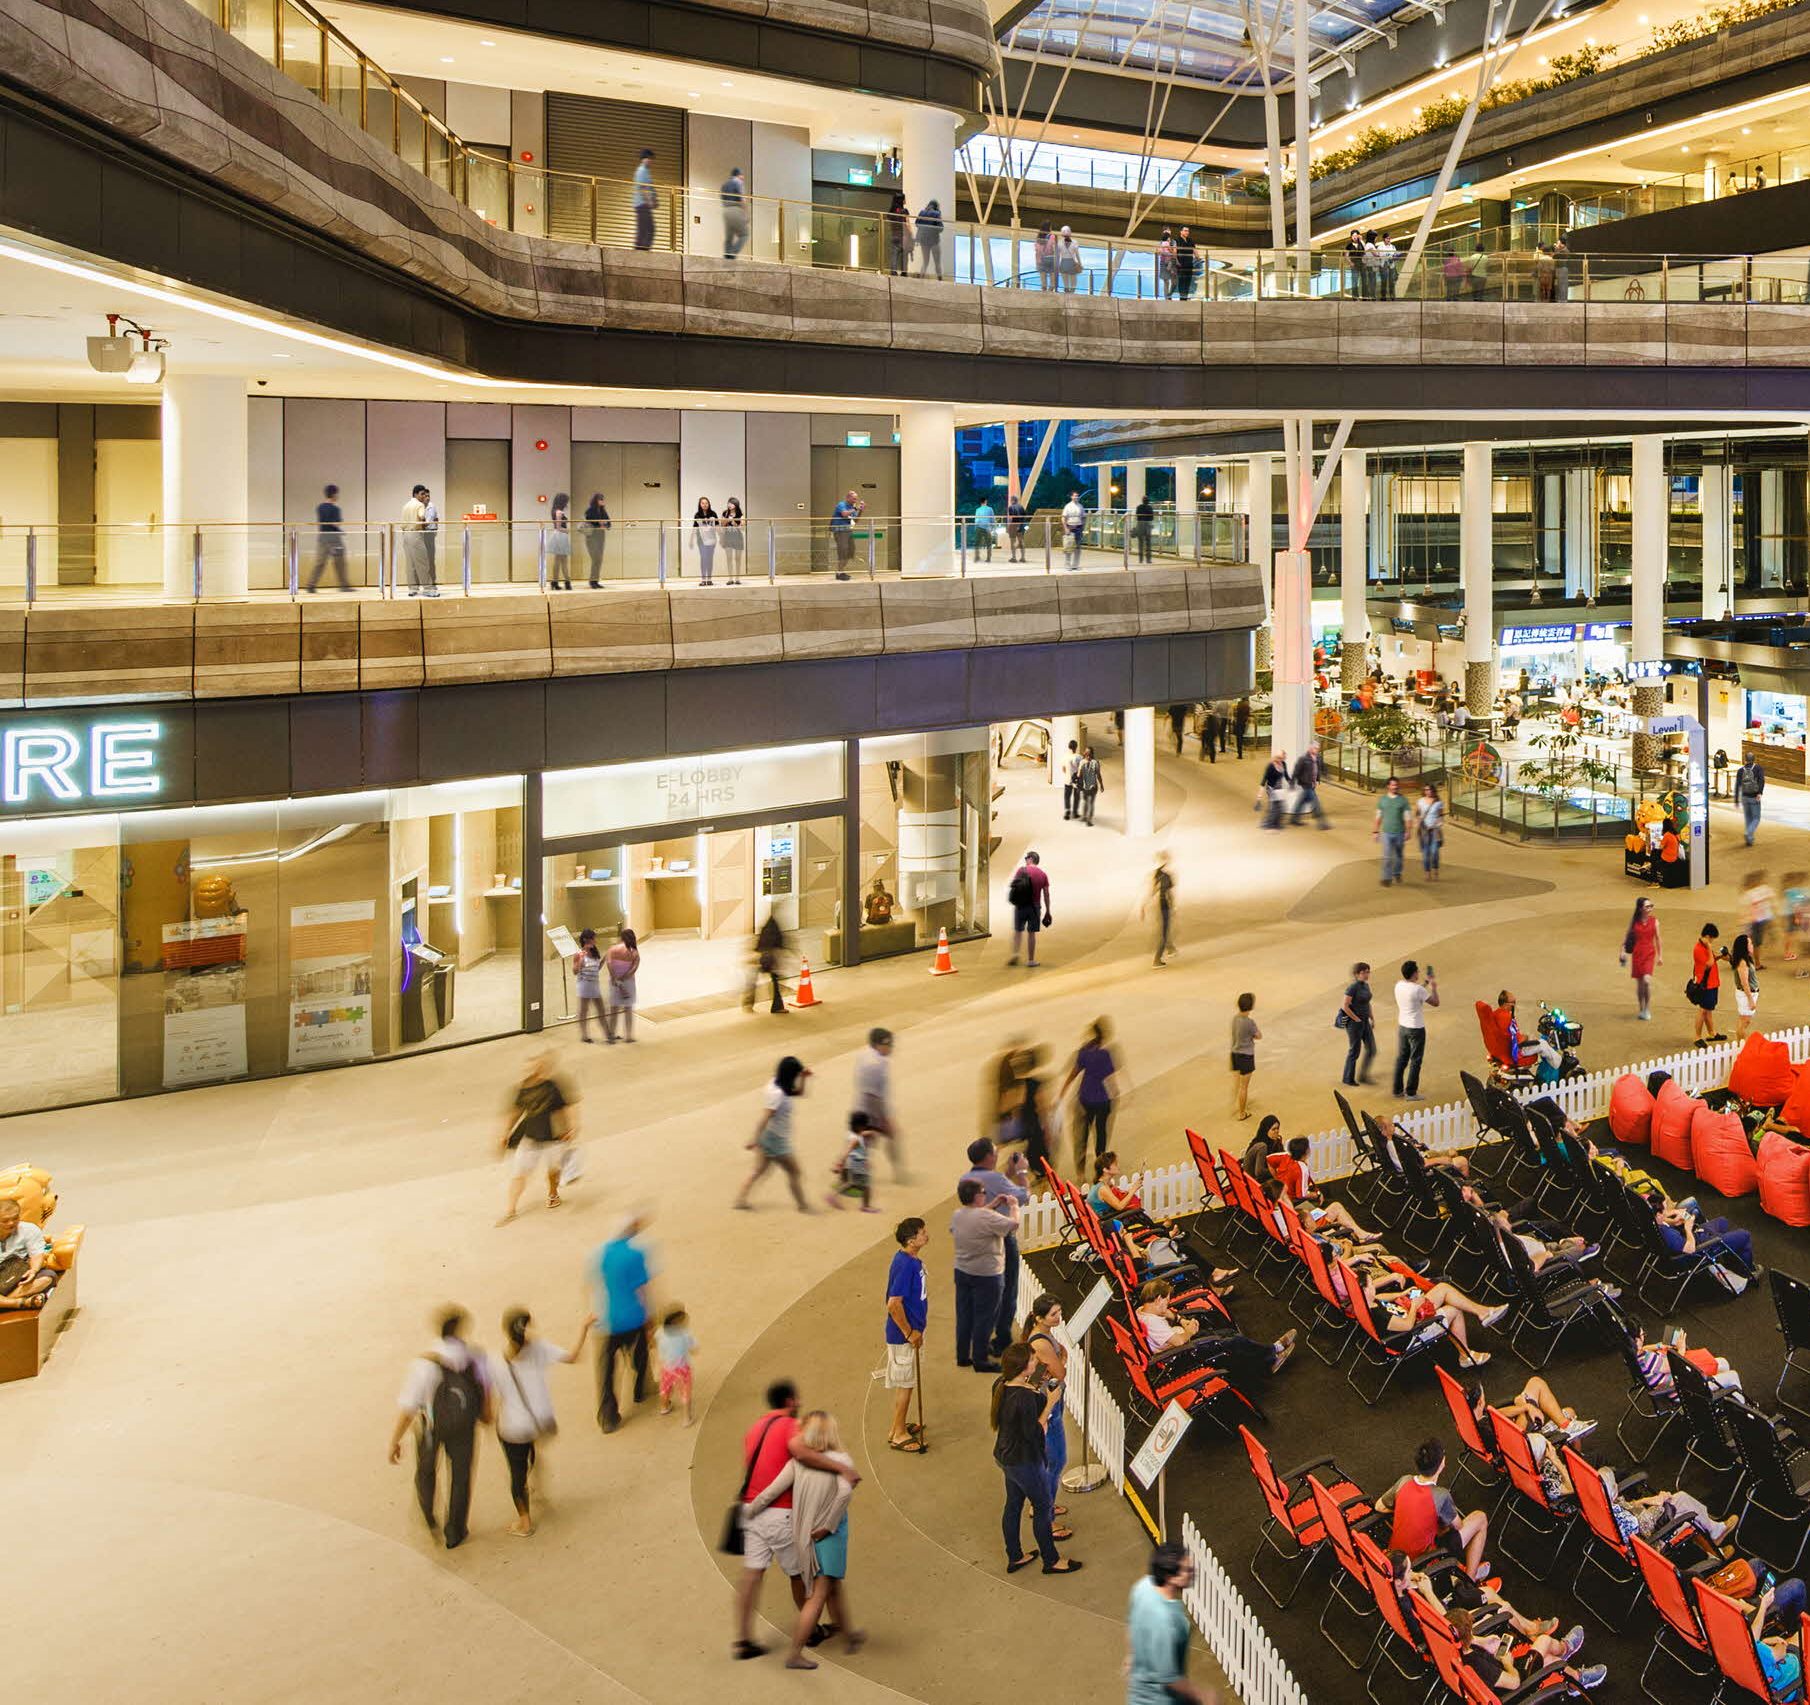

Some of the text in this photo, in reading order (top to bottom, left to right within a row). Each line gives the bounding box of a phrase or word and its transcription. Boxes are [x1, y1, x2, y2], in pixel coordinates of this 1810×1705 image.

[1653, 724, 1677, 734] Level
[4, 722, 160, 802] RE
[656, 766, 743, 789] E-LOBBY
[669, 786, 735, 808] 24 HRS
